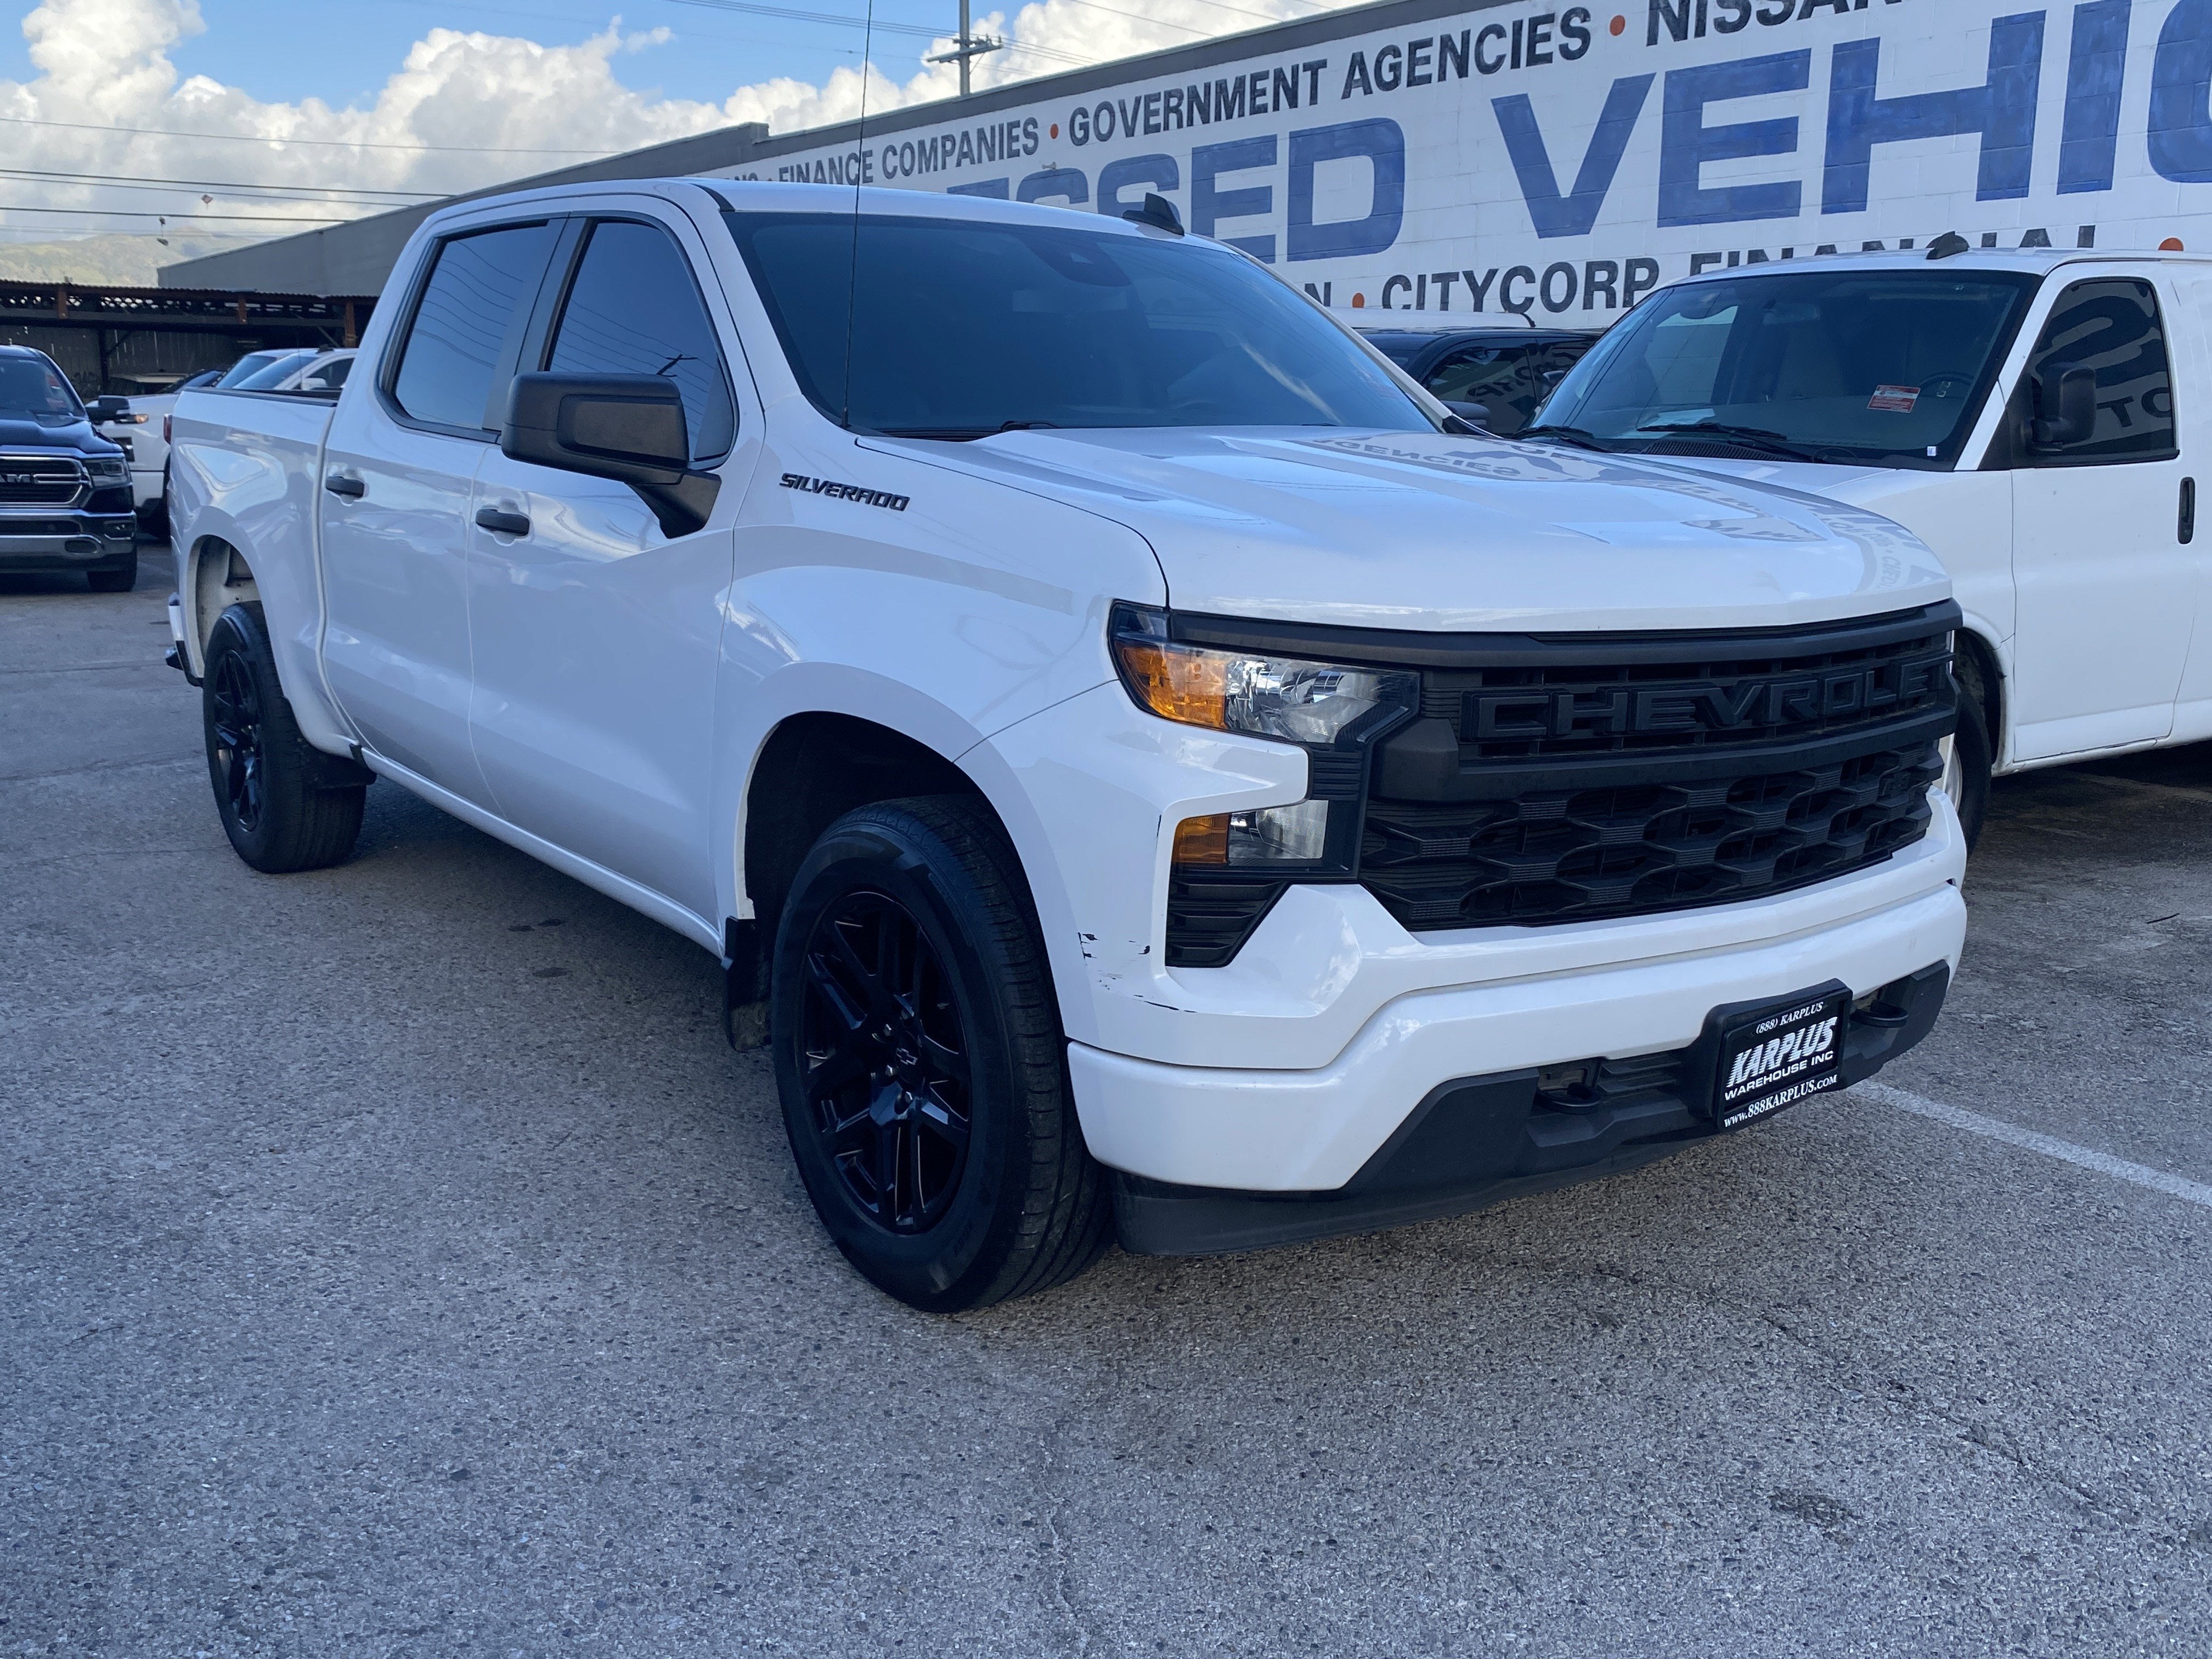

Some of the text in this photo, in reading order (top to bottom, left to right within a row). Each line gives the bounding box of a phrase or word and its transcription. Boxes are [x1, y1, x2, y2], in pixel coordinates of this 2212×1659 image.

[882, 116, 1039, 179] COMPANIES
[1069, 58, 1327, 146] GOVERNMENT
[1340, 6, 1592, 100] AGENCIES
[1646, 0, 1903, 47] NIS
[1381, 257, 1660, 313] CITYCORP
[779, 472, 911, 511] SILVERADO
[1756, 1001, 1824, 1034] (888) KARPLUS
[1724, 1051, 1834, 1101] WAREHOUSE INC
[1726, 1017, 1838, 1088] KARPLUS
